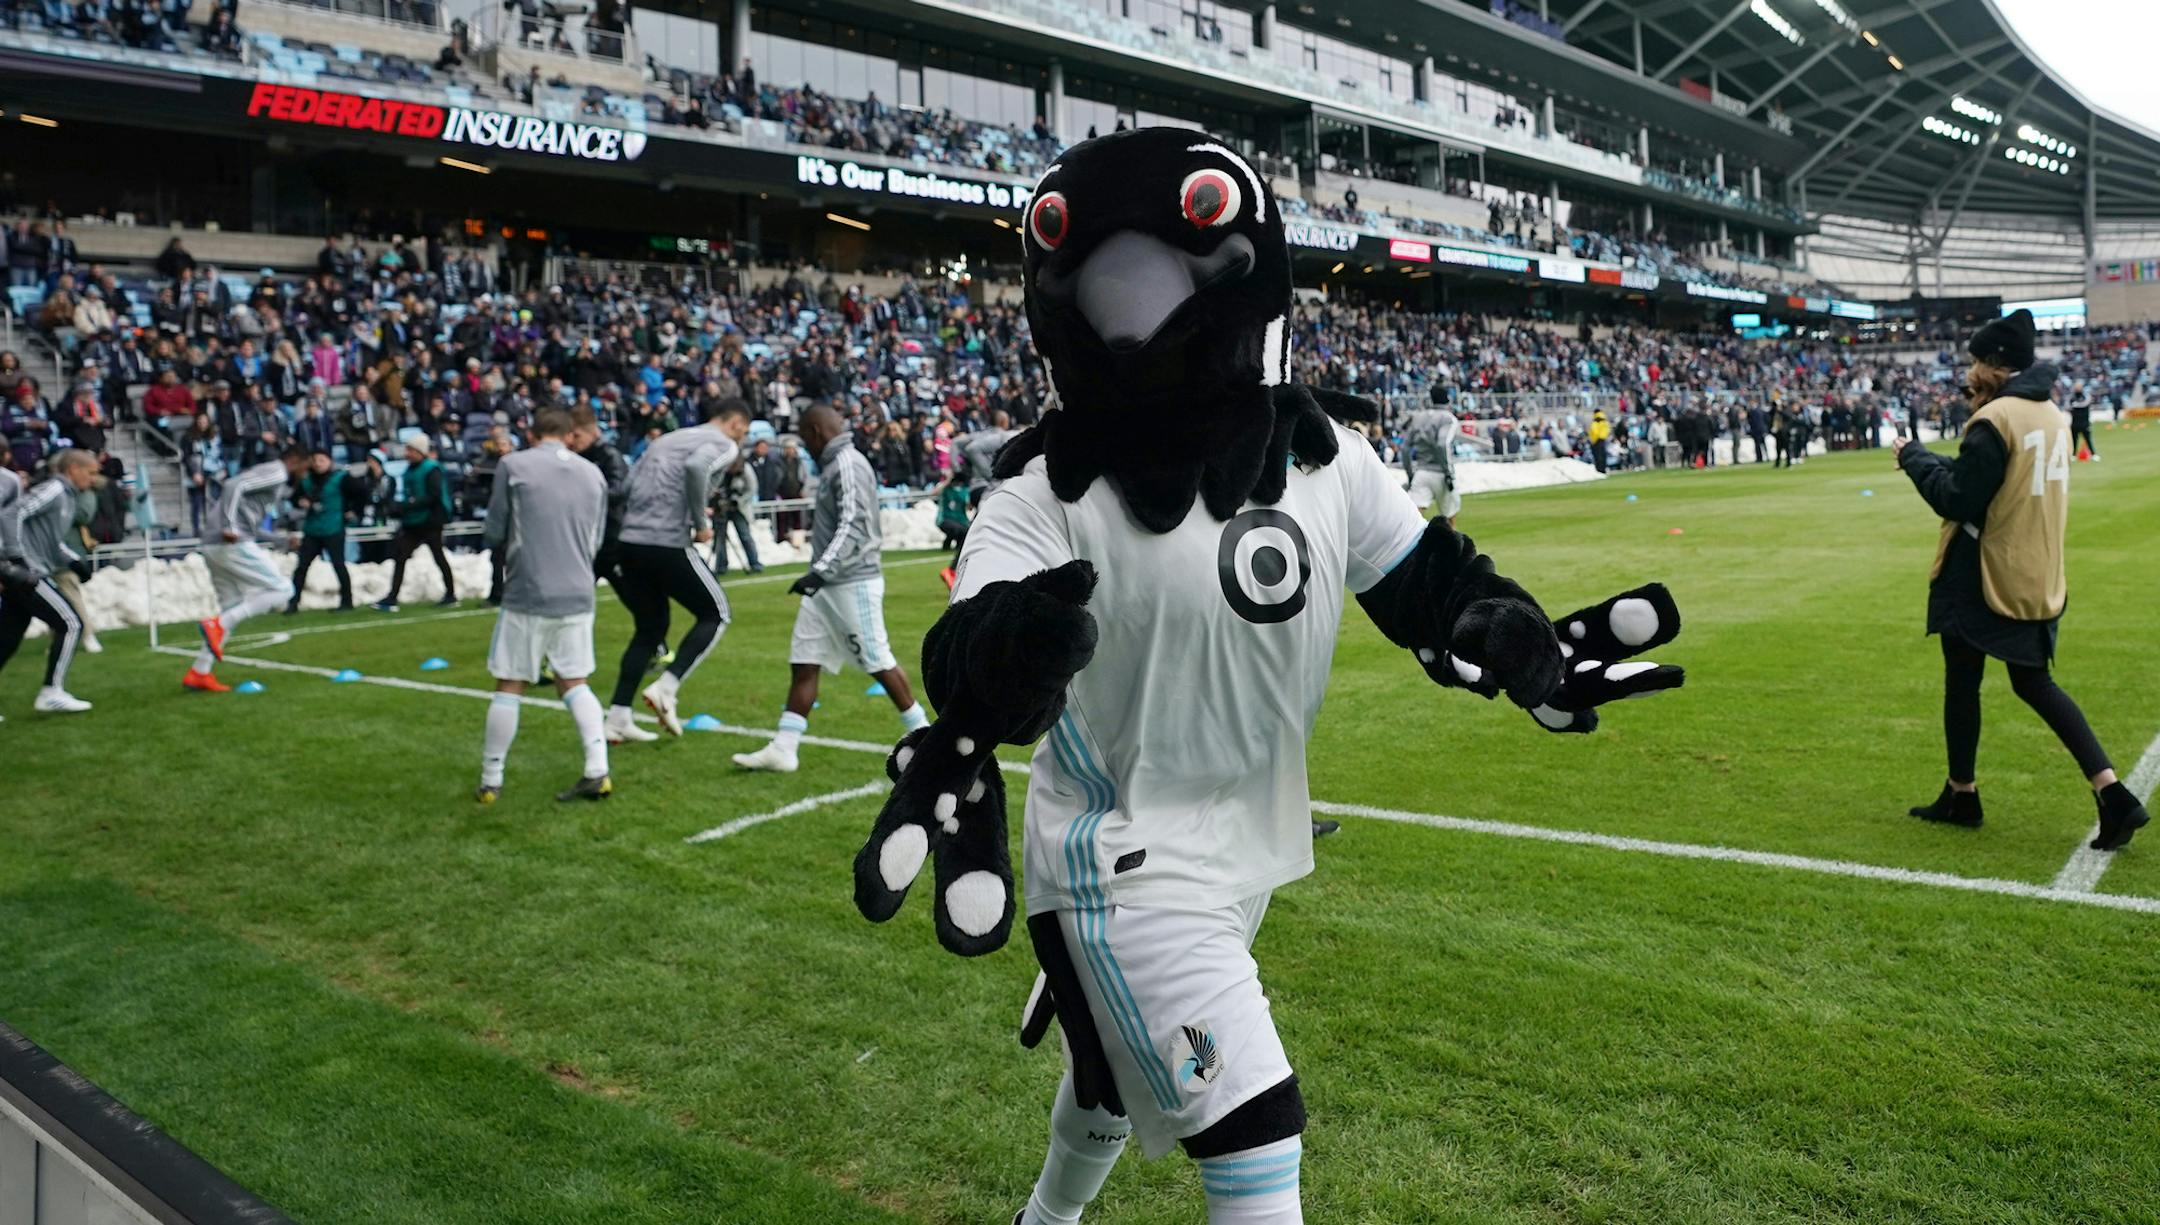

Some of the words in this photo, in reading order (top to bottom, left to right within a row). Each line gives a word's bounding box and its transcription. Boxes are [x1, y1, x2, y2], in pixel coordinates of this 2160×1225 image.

[247, 82, 444, 138] FEDERATED
[442, 107, 621, 161] INSURANCE
[798, 156, 838, 186] It's
[840, 162, 885, 191] Our
[887, 168, 985, 204] Business
[987, 182, 1011, 207] to
[1285, 223, 1349, 251] NSURANCE
[2023, 428, 2069, 496] 14
[848, 633, 862, 655] 5
